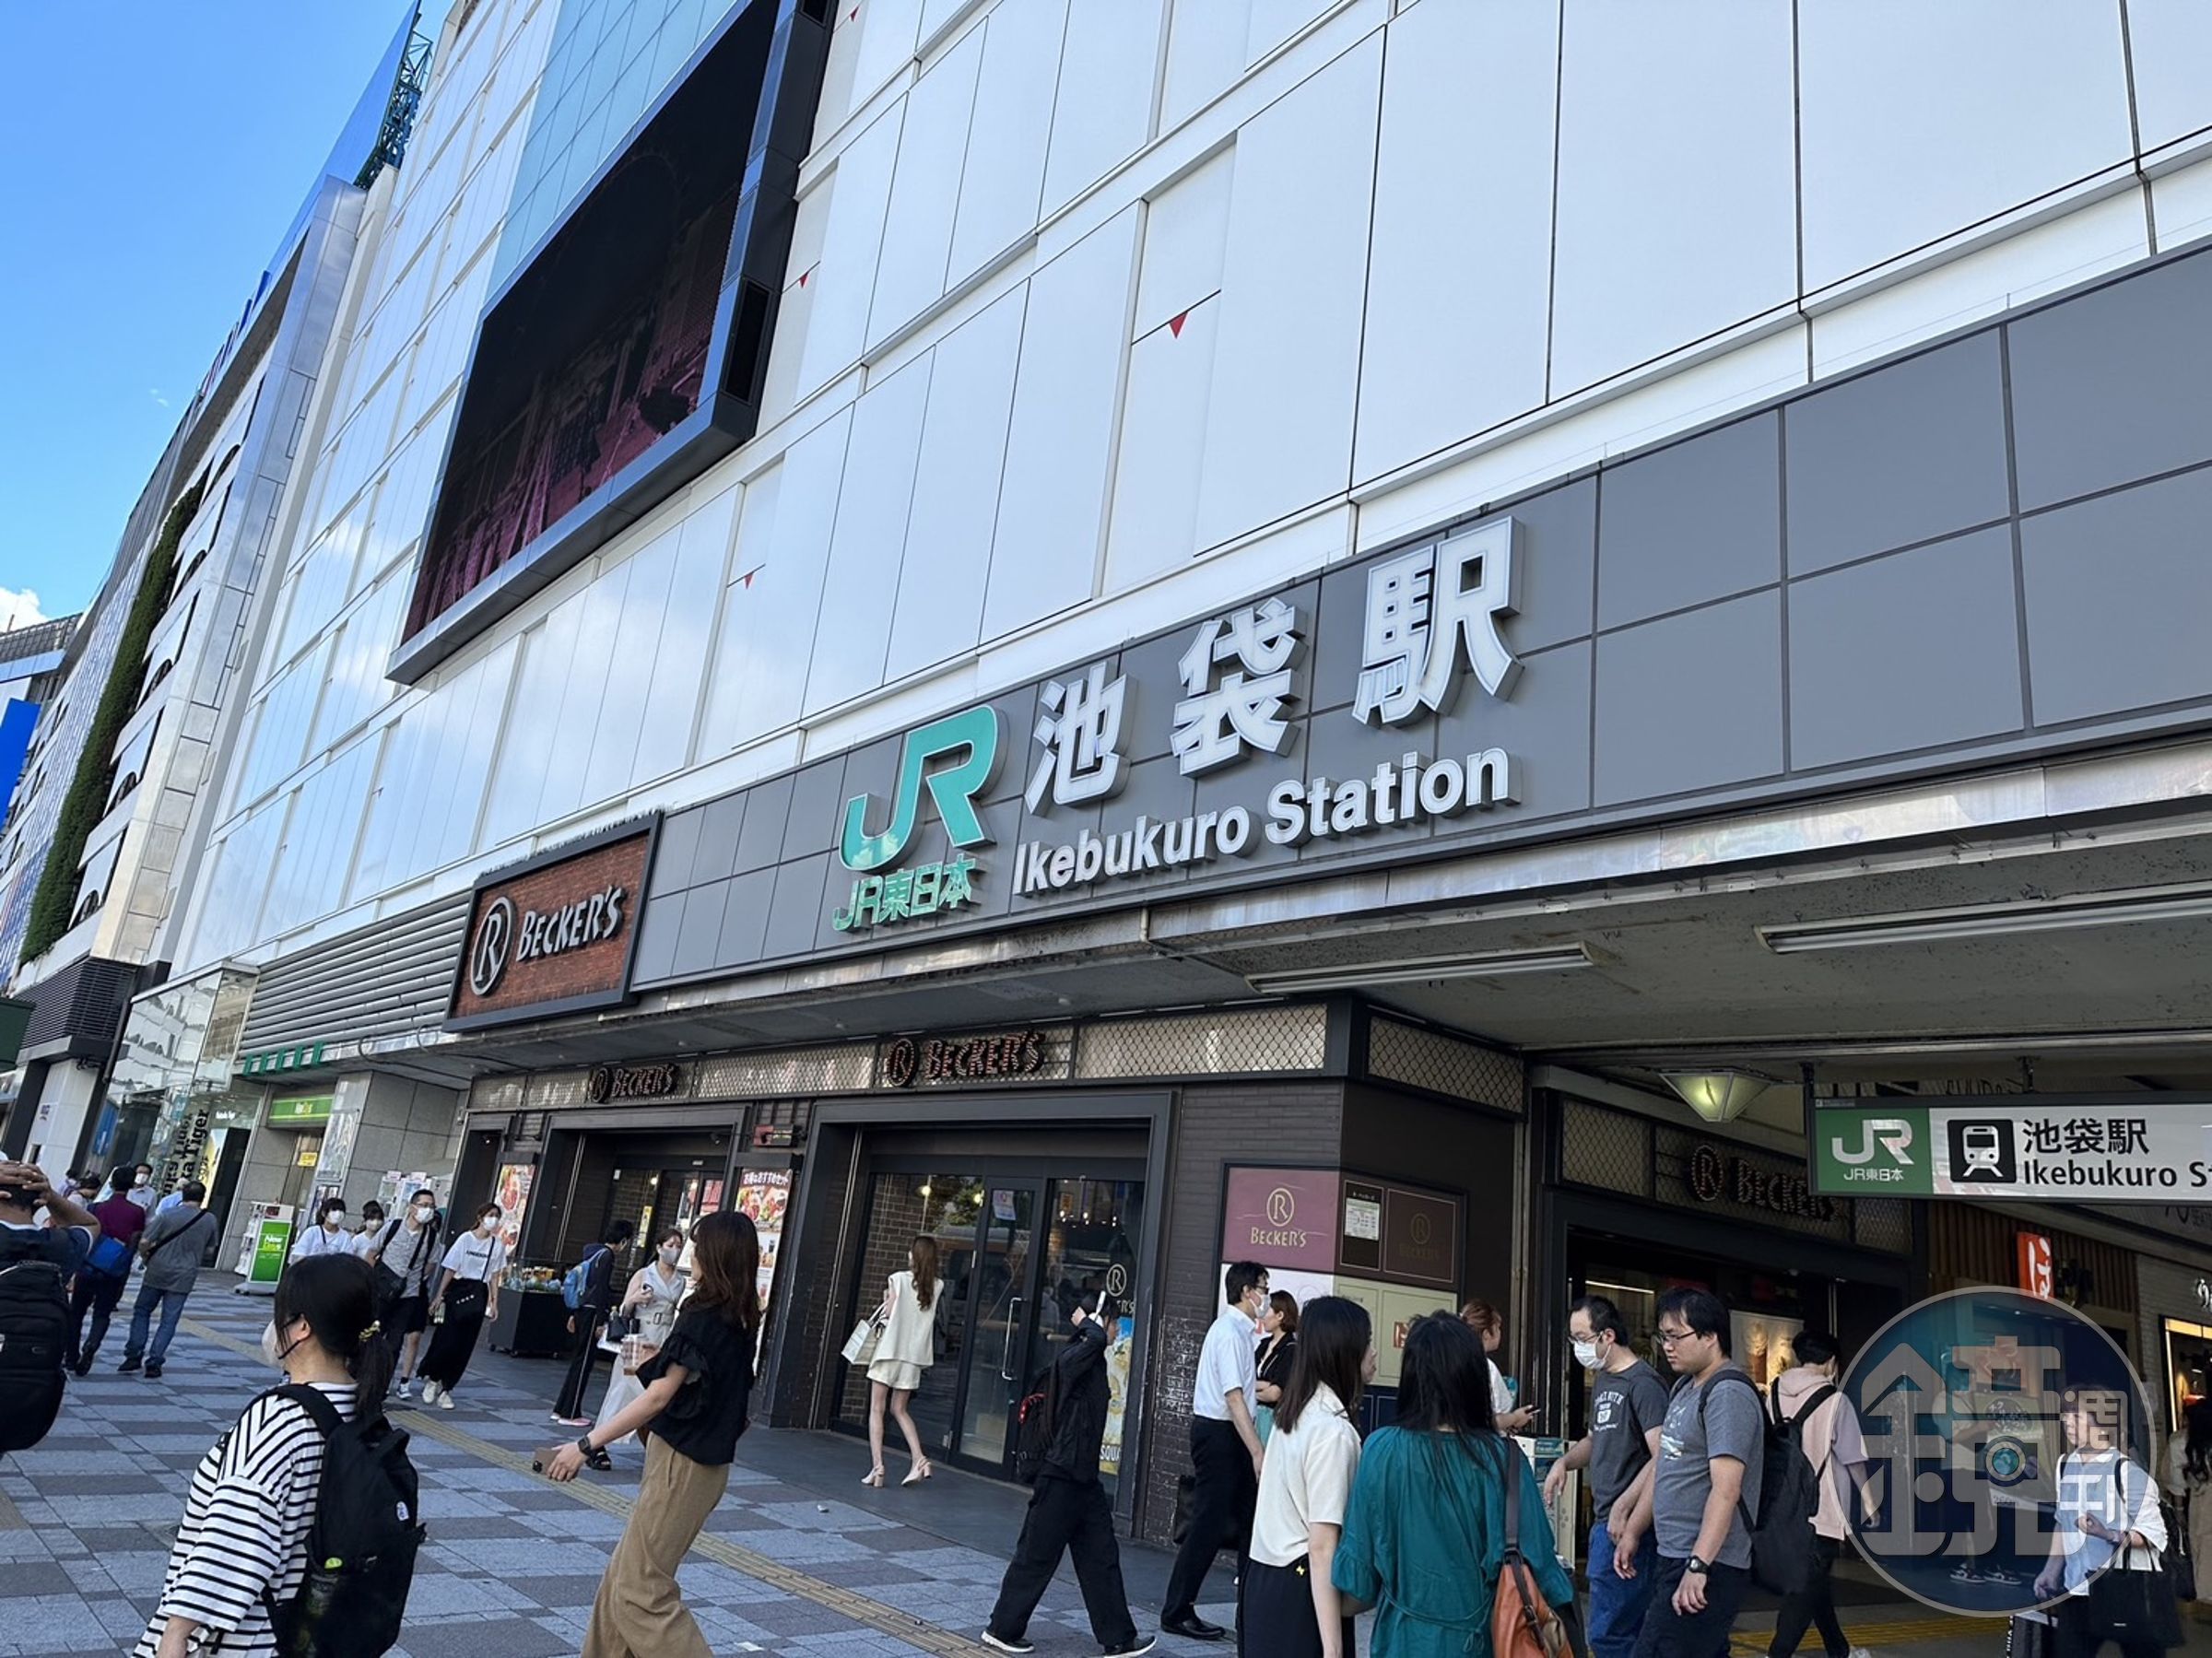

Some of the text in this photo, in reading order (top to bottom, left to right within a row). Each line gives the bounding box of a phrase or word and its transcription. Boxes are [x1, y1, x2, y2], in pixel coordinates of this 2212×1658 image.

[1024, 515, 1512, 815] 池袋駅
[839, 704, 998, 871] JR
[1013, 747, 1509, 896] Ikebukuro Station
[832, 853, 977, 931] JR東日本
[516, 885, 622, 961] BECKER'S
[924, 1029, 1041, 1079] BECKER'S
[1831, 1120, 1914, 1164] JR
[2022, 1118, 2149, 1154] 池袋駅
[1843, 1169, 1904, 1181] JR東日本
[2024, 1159, 2212, 1187] Ikebukuro S
[1251, 1227, 1306, 1248] BECKER'S
